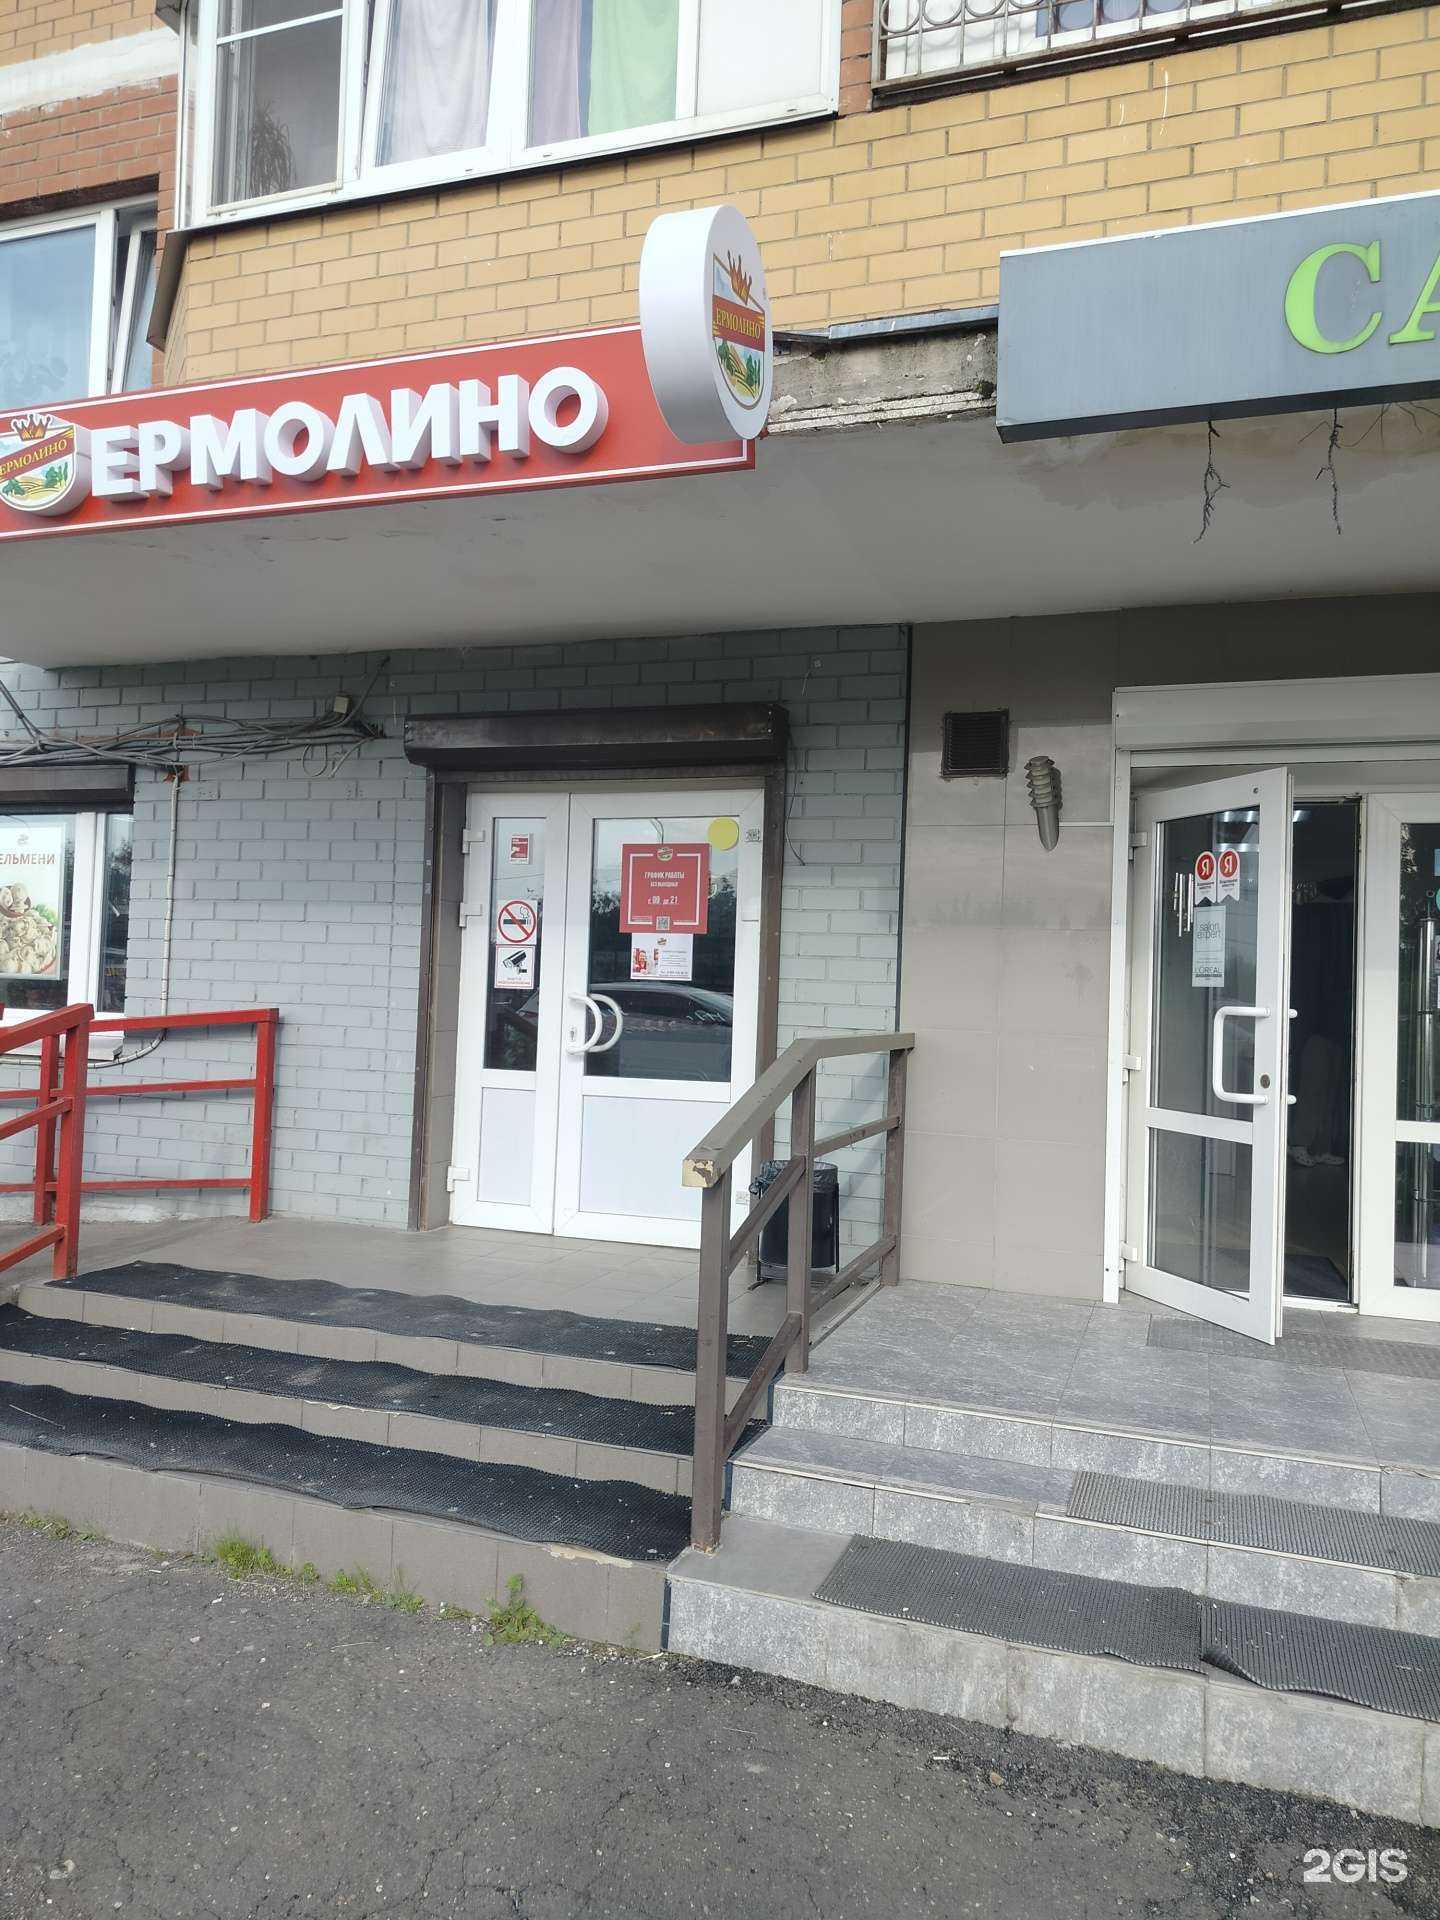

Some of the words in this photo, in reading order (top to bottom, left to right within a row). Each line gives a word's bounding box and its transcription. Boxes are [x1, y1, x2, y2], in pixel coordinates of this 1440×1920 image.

[716, 307, 761, 339] ЕРМОЛИНО
[91, 366, 608, 499] ЕРМОЛИНО
[0, 438, 68, 475] ЕРМОЛИНО
